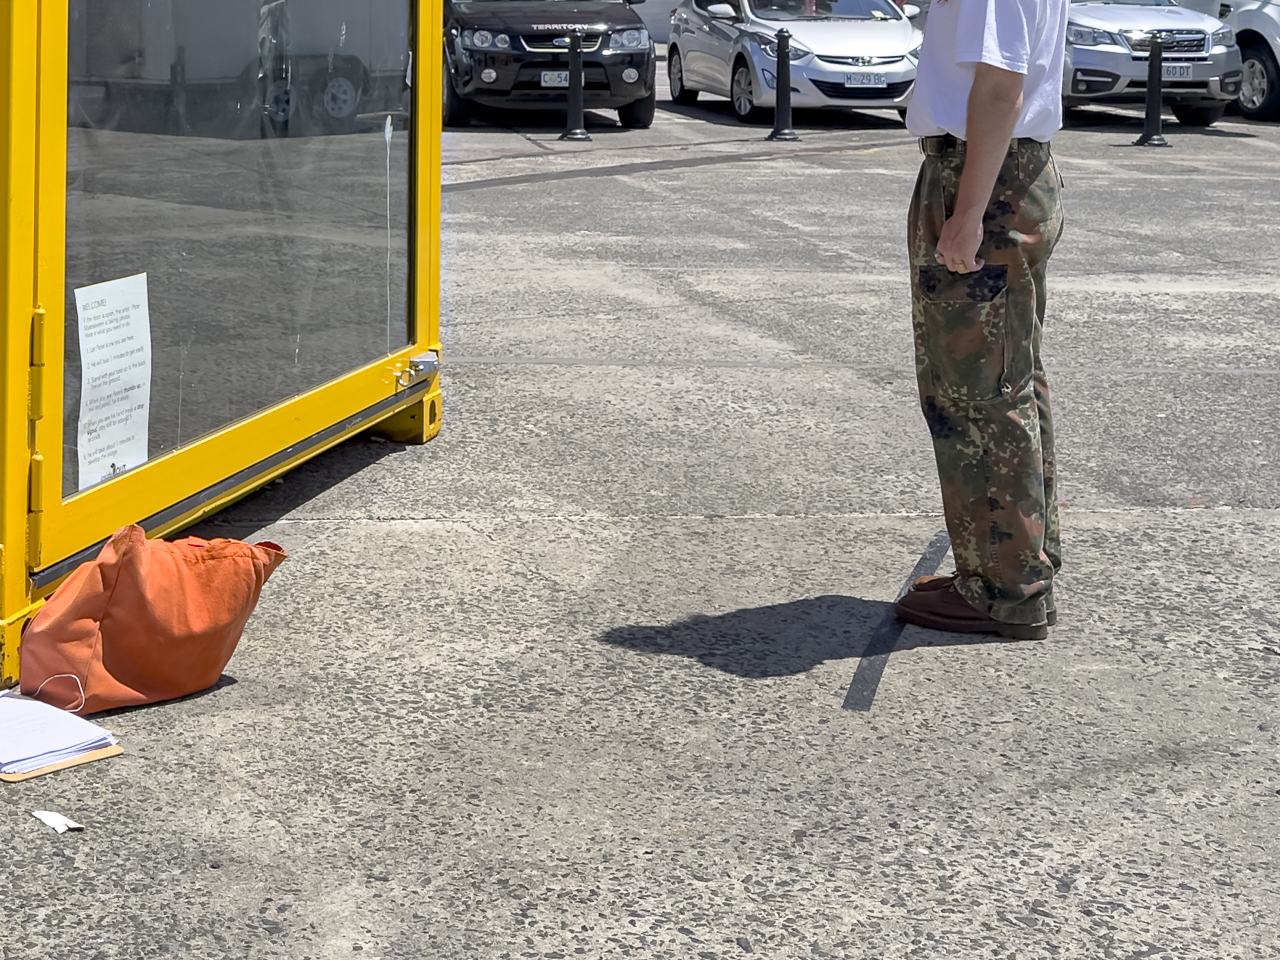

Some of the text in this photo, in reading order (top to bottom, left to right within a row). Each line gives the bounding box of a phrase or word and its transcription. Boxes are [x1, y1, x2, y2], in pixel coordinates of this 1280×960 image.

[1166, 66, 1190, 76] 60 DT
[557, 73, 568, 83] 54
